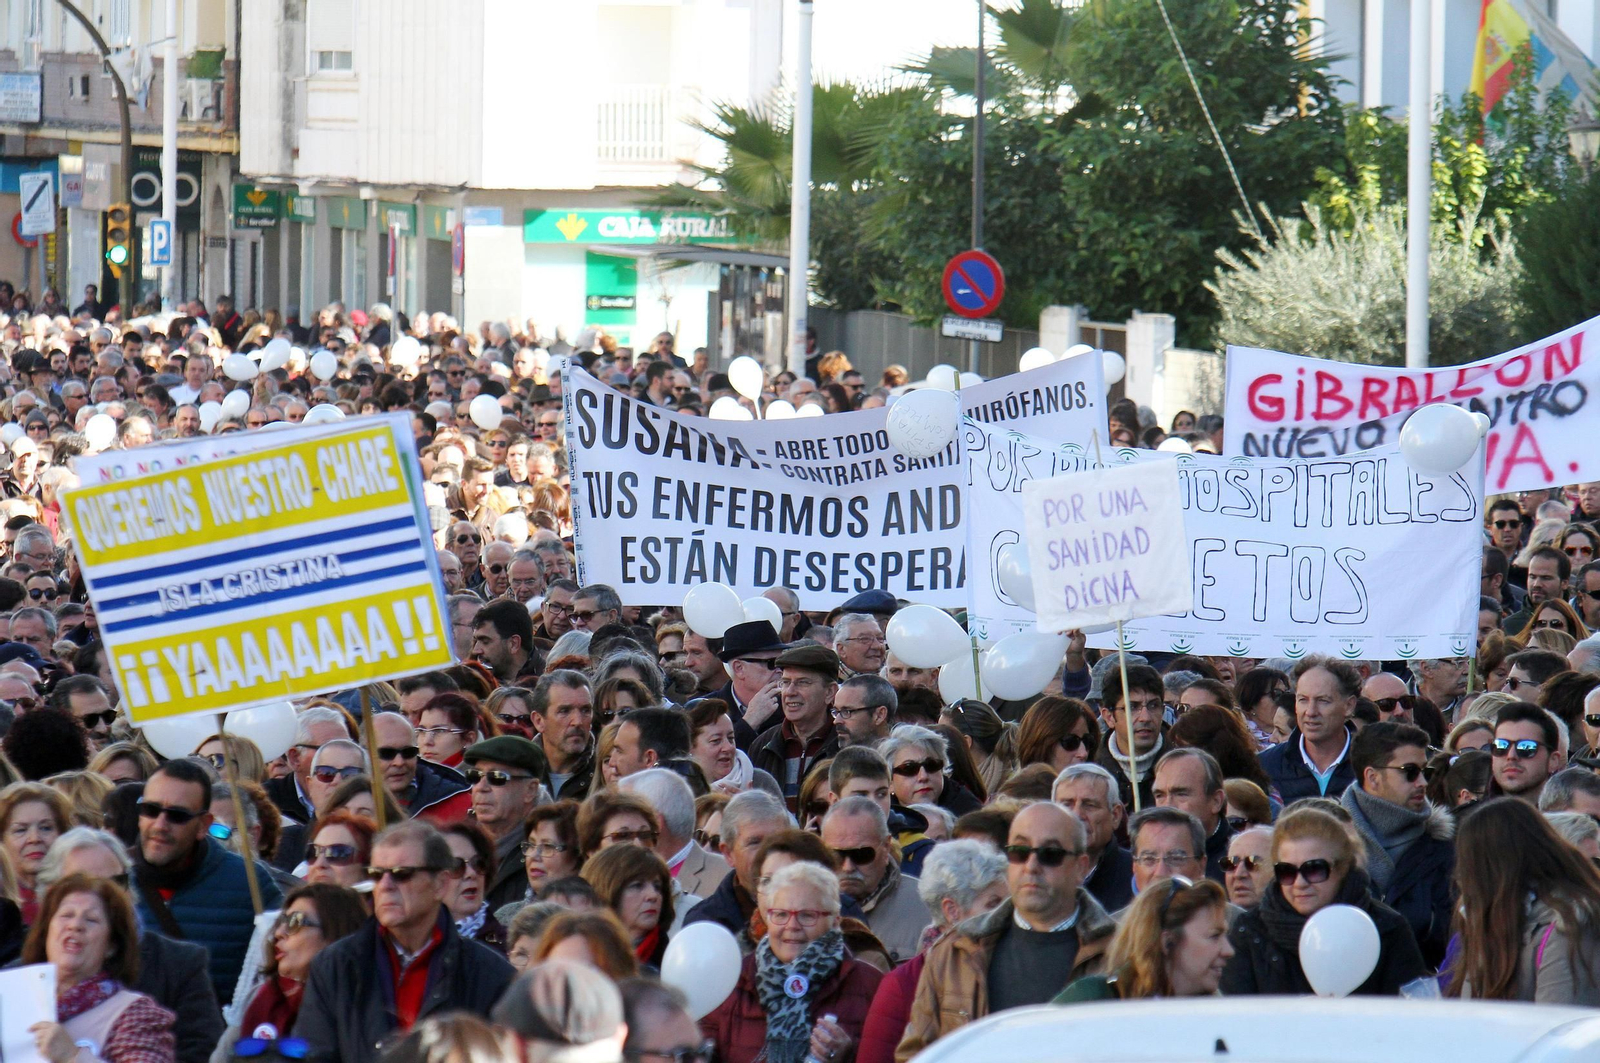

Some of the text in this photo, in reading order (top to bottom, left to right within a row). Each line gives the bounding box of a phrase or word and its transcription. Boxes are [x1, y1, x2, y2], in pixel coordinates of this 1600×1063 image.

[153, 224, 168, 262] P
[598, 216, 656, 238] CAJA
[775, 438, 829, 460] ABRE
[963, 381, 1093, 423] UIRÓFANOS.
[1243, 381, 1588, 458] NUEVO NTRO
[75, 435, 399, 553] QUEREMOS NUESTRO CHARE
[100, 464, 125, 481] NO
[780, 458, 888, 486] CONTRATA
[1178, 458, 1477, 528] OSPITALES
[583, 471, 961, 538] TUS ENFERMOS AND
[1043, 487, 1148, 529] POR UNA
[156, 554, 346, 614] ISLA CRISTINA
[621, 530, 738, 586] ESTÁN
